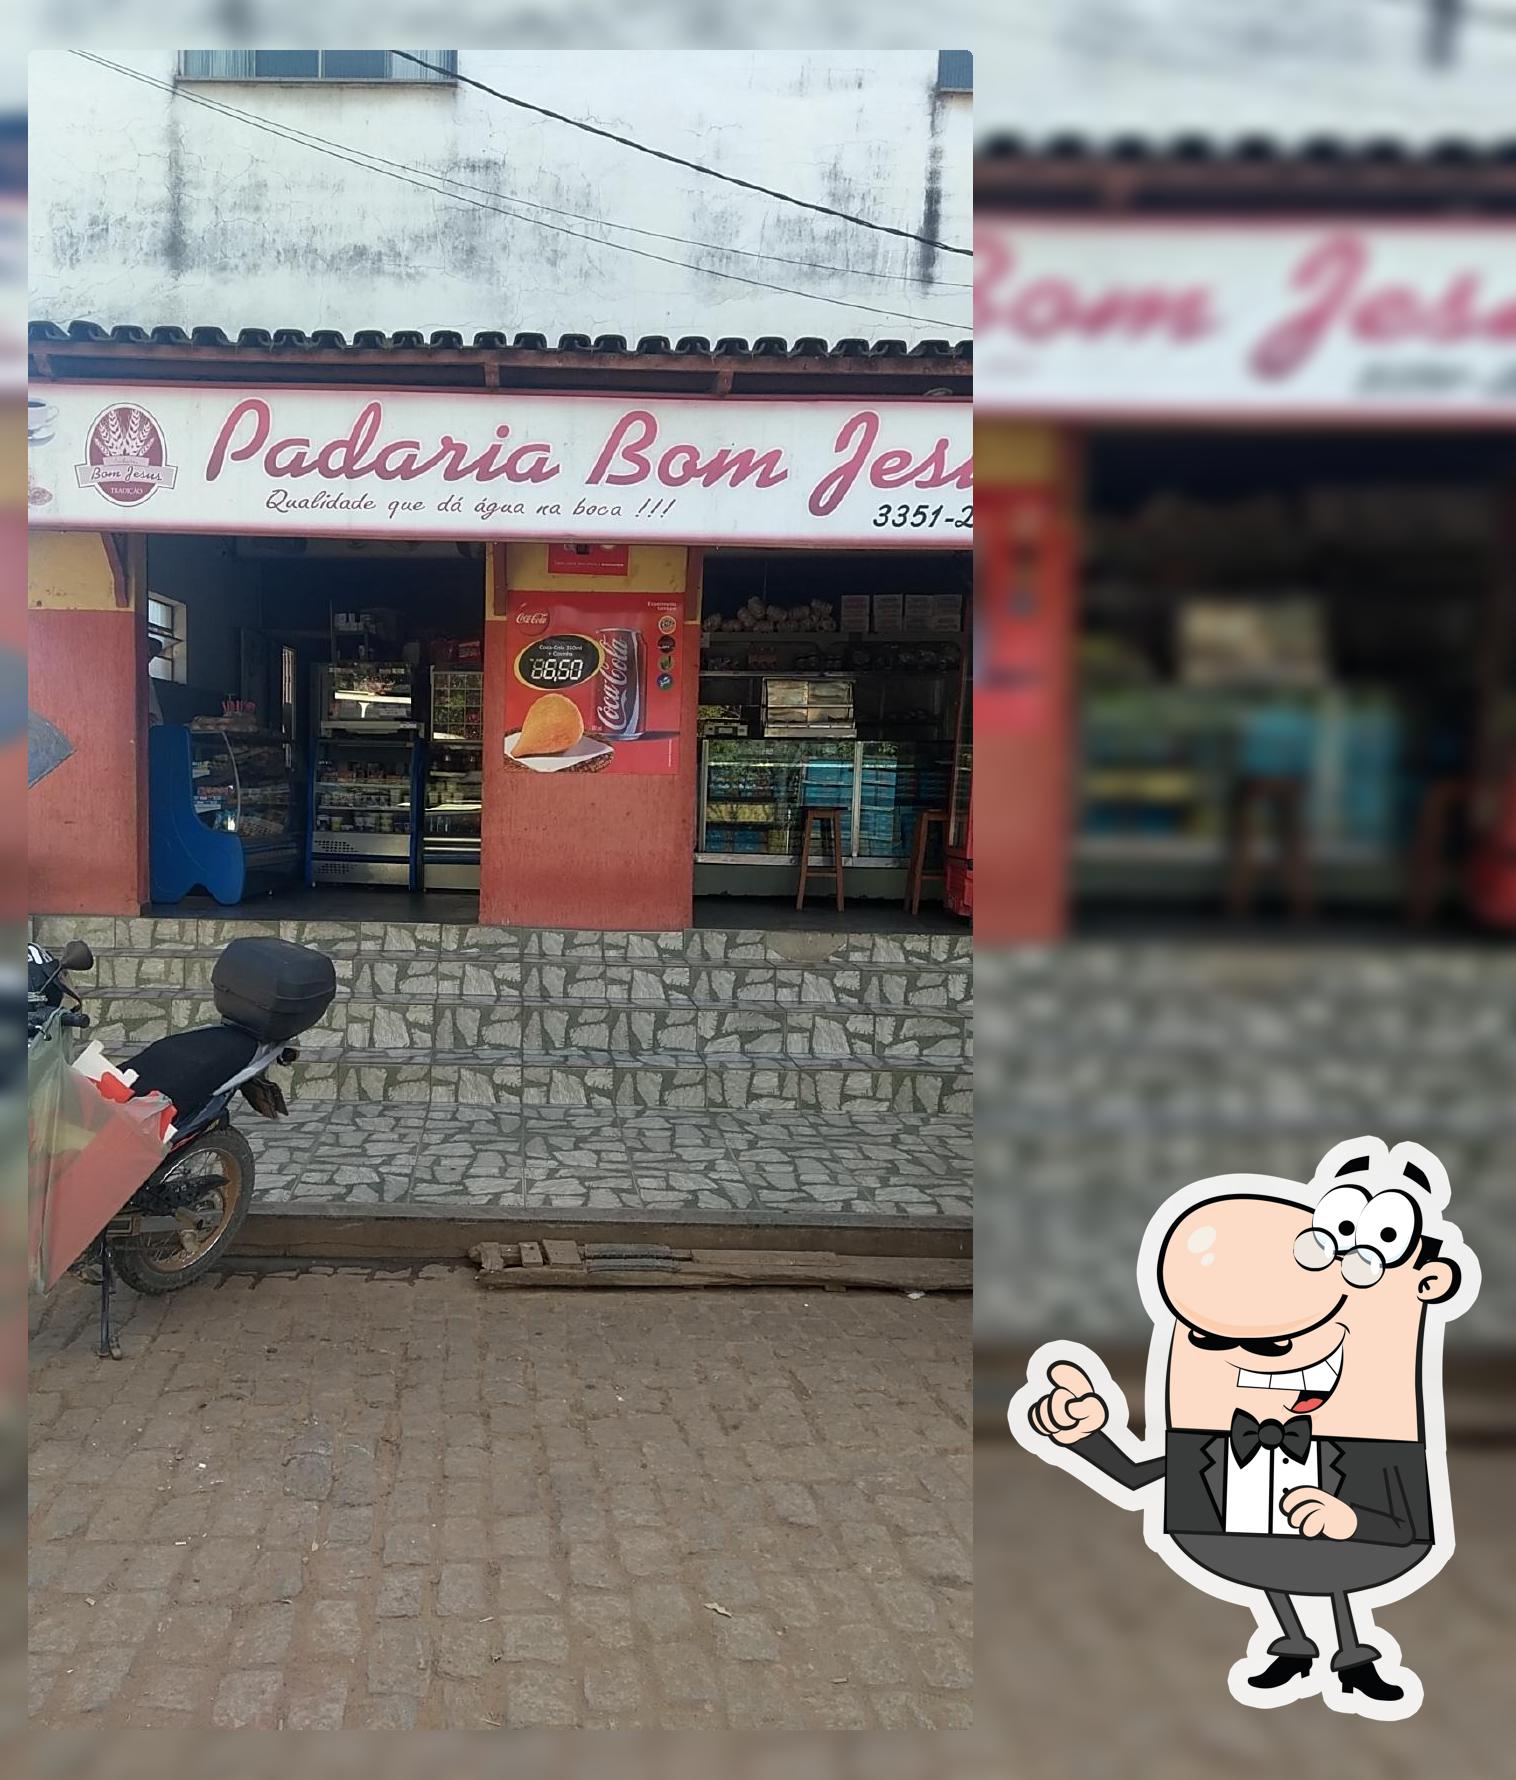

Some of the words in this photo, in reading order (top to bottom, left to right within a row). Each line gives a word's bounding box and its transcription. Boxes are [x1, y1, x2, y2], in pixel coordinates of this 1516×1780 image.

[205, 398, 560, 483] Padaria
[585, 409, 788, 489] Bom
[91, 466, 121, 480] Bom
[124, 465, 162, 481] Jesus
[266, 489, 376, 513] Qualidade
[388, 498, 425, 519] que
[437, 494, 464, 513] dá
[473, 497, 525, 520] água
[536, 502, 561, 516] na
[573, 498, 622, 516] boca
[873, 504, 973, 529] 3351-2
